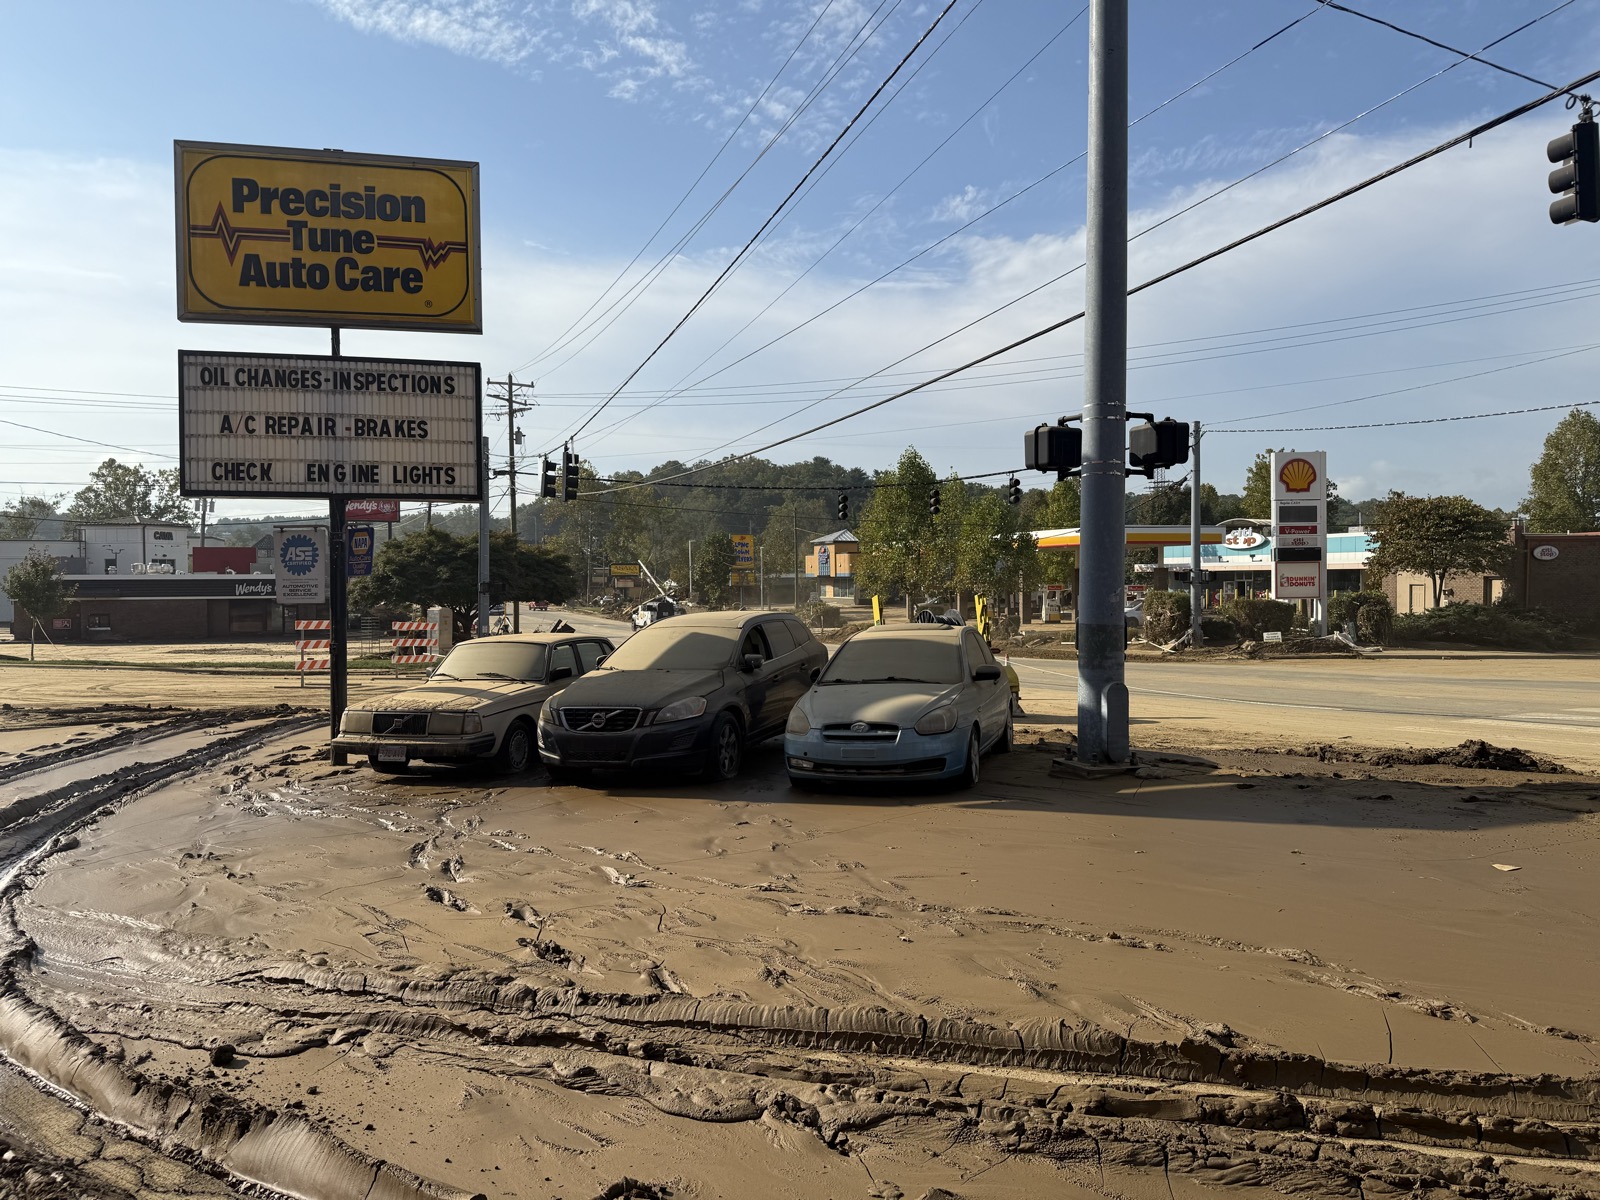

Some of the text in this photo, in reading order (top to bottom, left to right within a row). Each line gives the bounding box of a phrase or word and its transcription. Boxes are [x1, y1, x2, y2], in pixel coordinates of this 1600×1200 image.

[231, 177, 426, 223] Precision
[286, 219, 375, 255] Tune
[238, 253, 424, 294] Auto Care
[199, 366, 230, 387] OIL
[219, 414, 257, 435] A/C
[264, 415, 337, 437] REPAIR
[211, 461, 456, 485] CHECK ENGINE LIGHTS
[345, 500, 378, 514] endy's
[285, 546, 312, 560] ASE
[354, 537, 368, 548] NAPA
[236, 582, 272, 596] Wendy's
